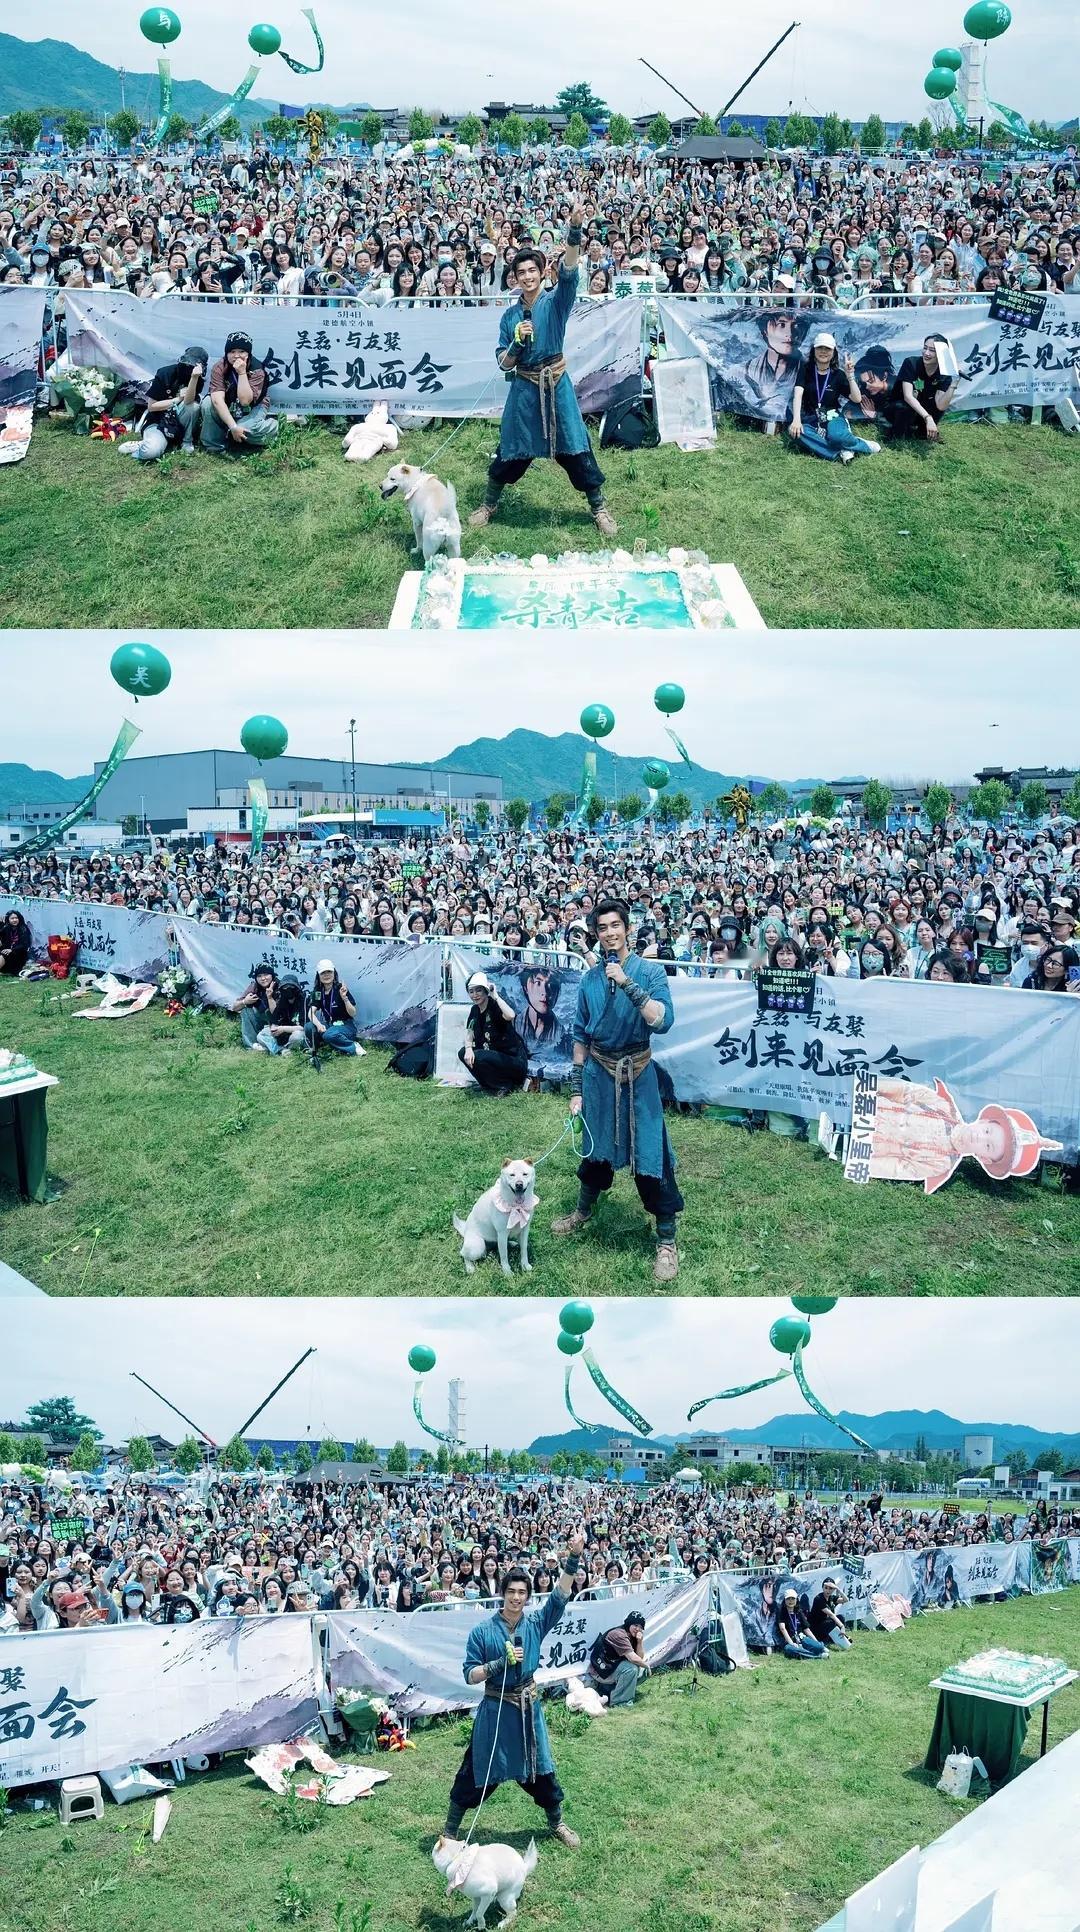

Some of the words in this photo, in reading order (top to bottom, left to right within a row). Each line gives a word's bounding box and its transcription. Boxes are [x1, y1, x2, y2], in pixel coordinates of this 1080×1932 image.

[337, 311, 362, 319] 5月4日
[262, 347, 453, 394] 剑来见面会
[129, 666, 151, 688] 吴
[595, 711, 608, 729] 与
[846, 1070, 877, 1182] 吴磊小皇帝
[0, 1666, 26, 1695] 聚
